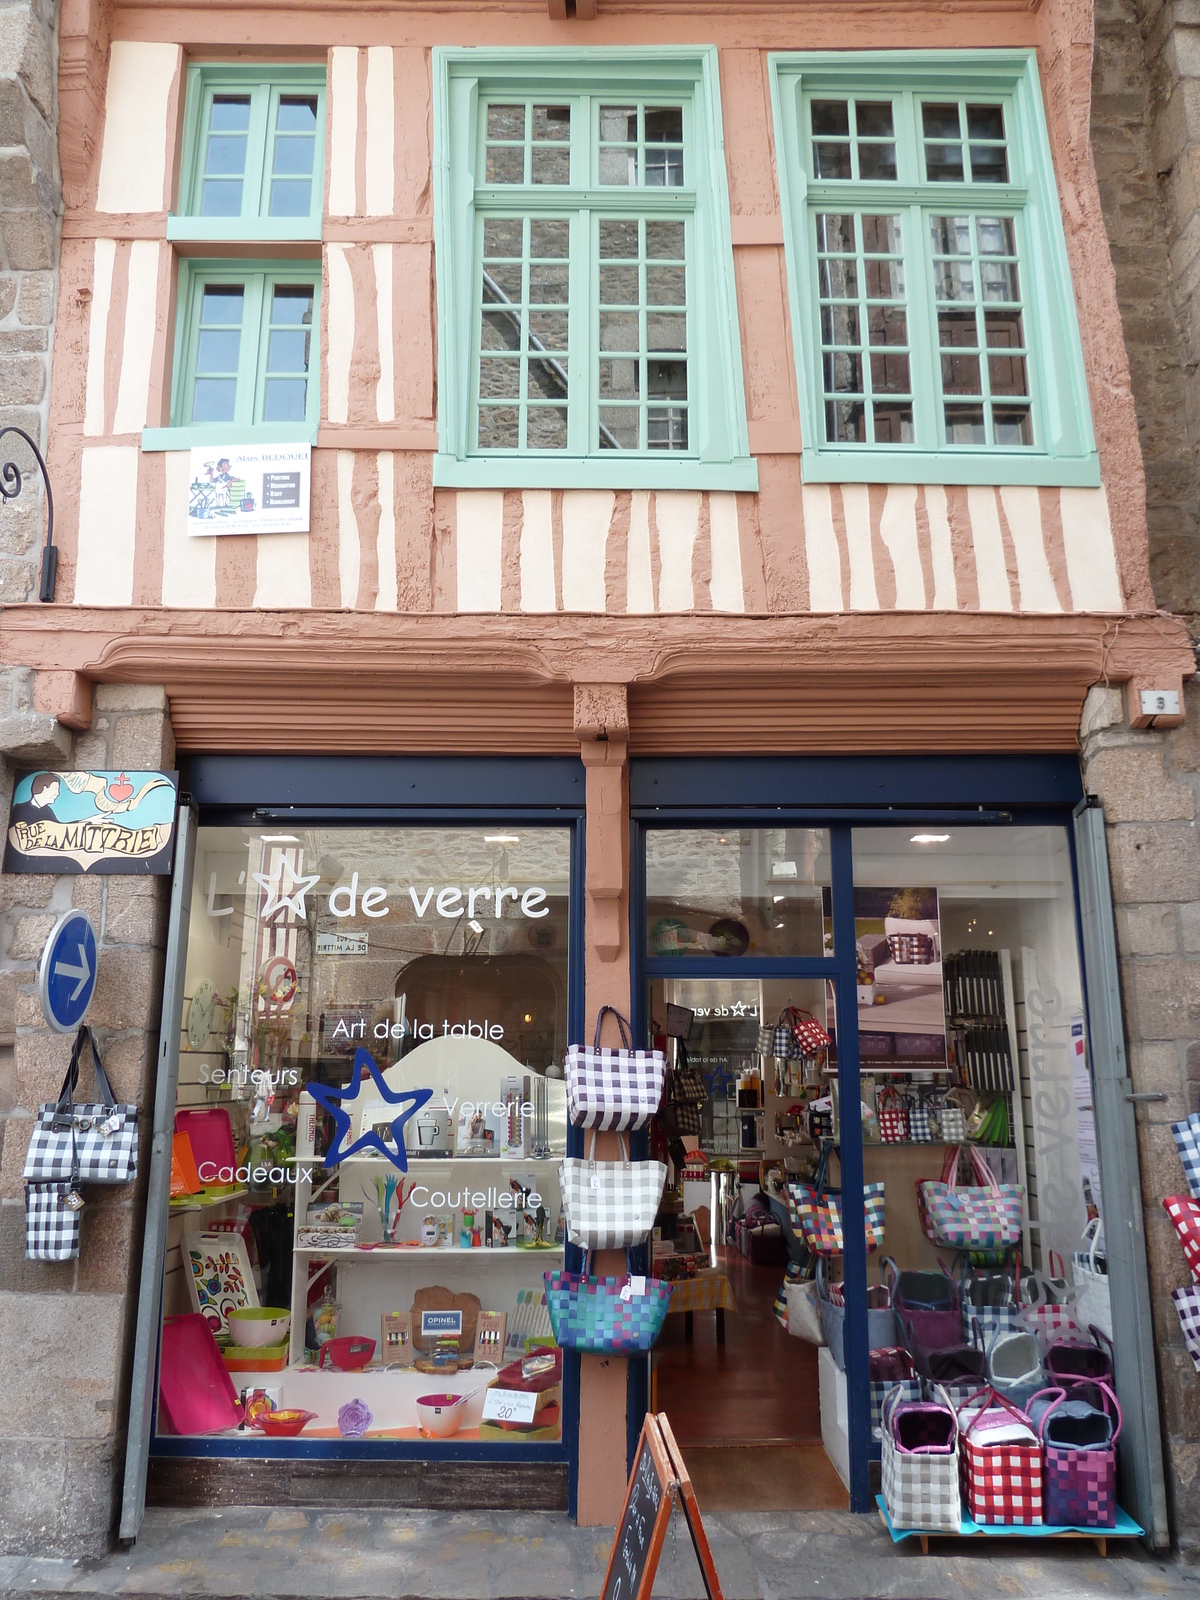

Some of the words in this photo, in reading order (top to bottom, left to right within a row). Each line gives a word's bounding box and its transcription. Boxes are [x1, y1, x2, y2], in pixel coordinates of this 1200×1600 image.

[1156, 696, 1165, 710] 3
[20, 822, 46, 840] RUE
[25, 838, 42, 849] DE
[45, 835, 58, 848] LA
[58, 825, 155, 852] MITTRIE
[328, 871, 390, 918] de
[409, 886, 550, 919] verre
[332, 1018, 366, 1039] Art
[373, 1018, 406, 1039] de
[412, 1018, 434, 1039] la
[442, 1018, 505, 1039] table
[198, 1063, 298, 1086] Senteurs
[442, 1097, 535, 1118] Verrerie
[308, 1113, 316, 1143] THERMOS
[198, 1161, 313, 1184] Cadeaux
[410, 1186, 542, 1209] Coutellerie
